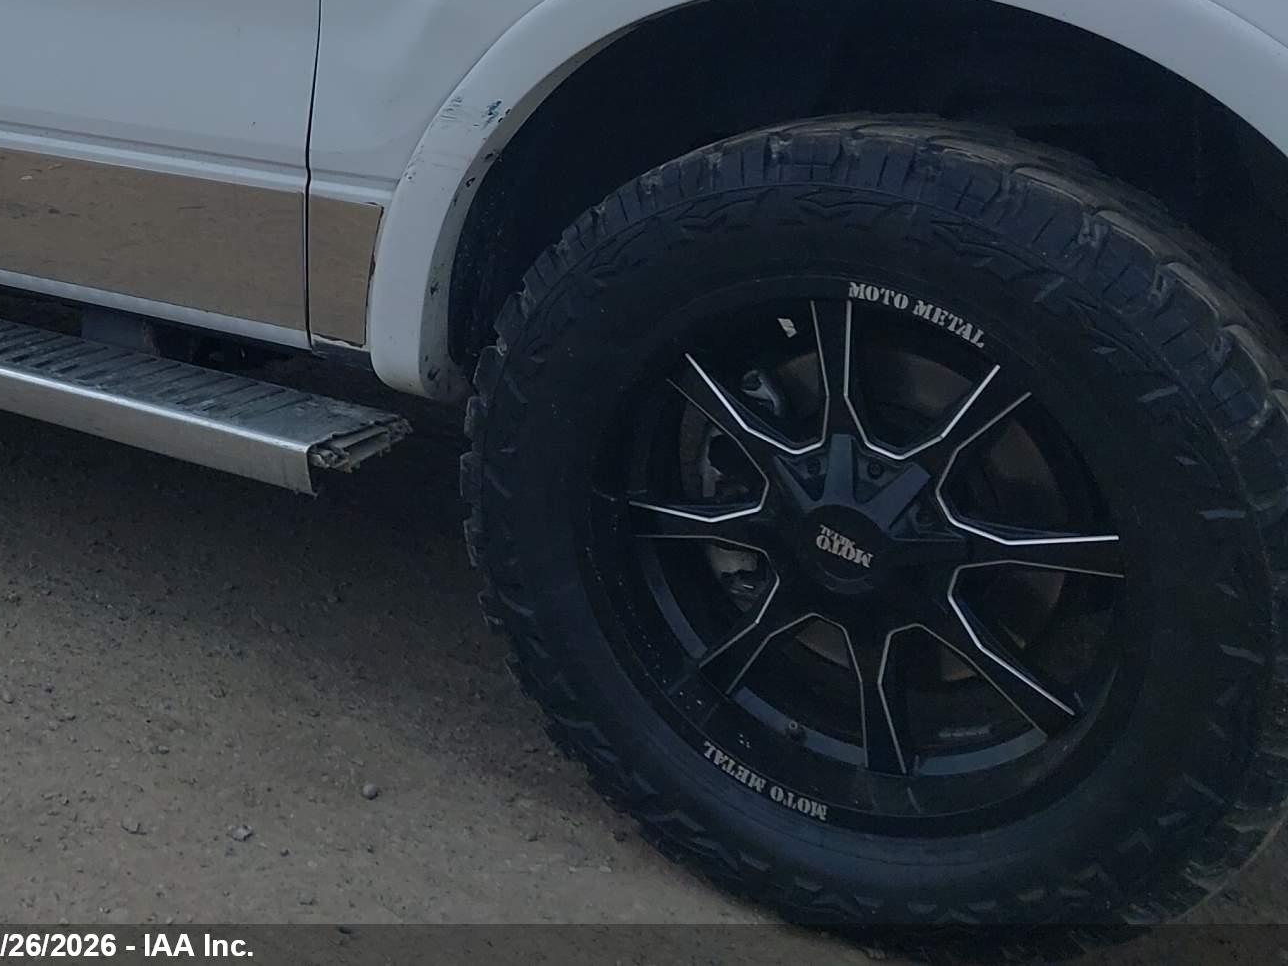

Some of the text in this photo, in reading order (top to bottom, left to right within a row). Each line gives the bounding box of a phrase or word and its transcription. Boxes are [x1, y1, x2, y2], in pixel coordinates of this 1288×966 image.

[848, 282, 985, 349] MOTO METAL
[815, 534, 875, 569] MOTO
[703, 740, 829, 821] MOTO METAL
